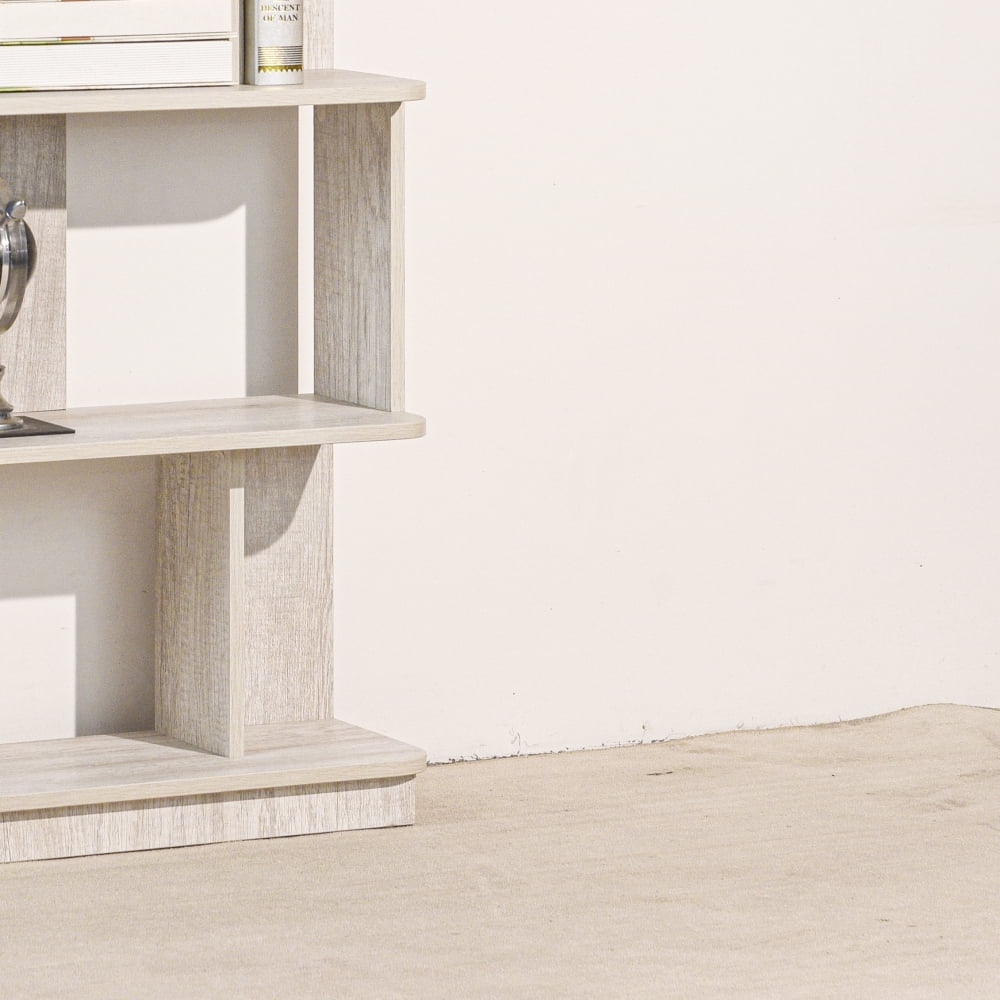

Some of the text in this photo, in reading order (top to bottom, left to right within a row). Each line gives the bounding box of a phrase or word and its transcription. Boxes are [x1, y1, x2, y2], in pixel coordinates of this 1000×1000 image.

[260, 4, 301, 12] DESCENT
[262, 14, 299, 22] OF MAN
